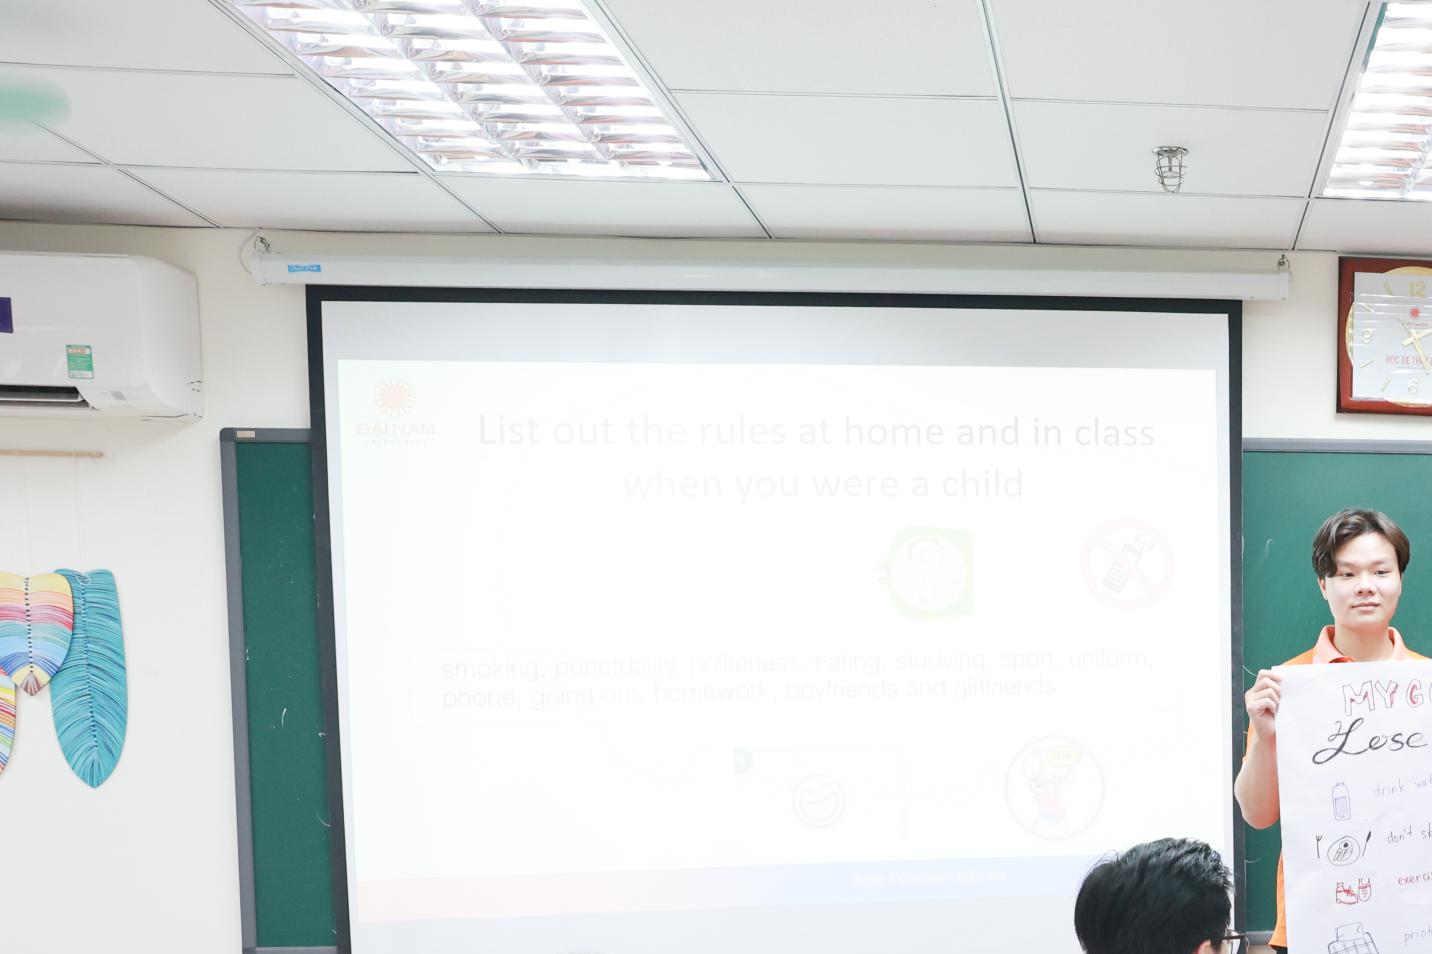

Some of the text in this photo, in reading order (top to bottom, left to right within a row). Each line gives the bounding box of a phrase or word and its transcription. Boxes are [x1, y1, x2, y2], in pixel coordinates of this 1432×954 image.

[1408, 281, 1425, 298] 12
[478, 413, 1155, 447] List out the rules at home and in class
[624, 467, 1023, 504] when you were a child
[530, 687, 594, 711] going
[786, 680, 899, 704] boyfriends
[905, 678, 946, 698] and
[953, 675, 1056, 702] girlfriends
[1342, 679, 1400, 717] MY
[1312, 716, 1429, 765] Lose
[1373, 777, 1405, 798] drink
[1387, 823, 1414, 844] don't
